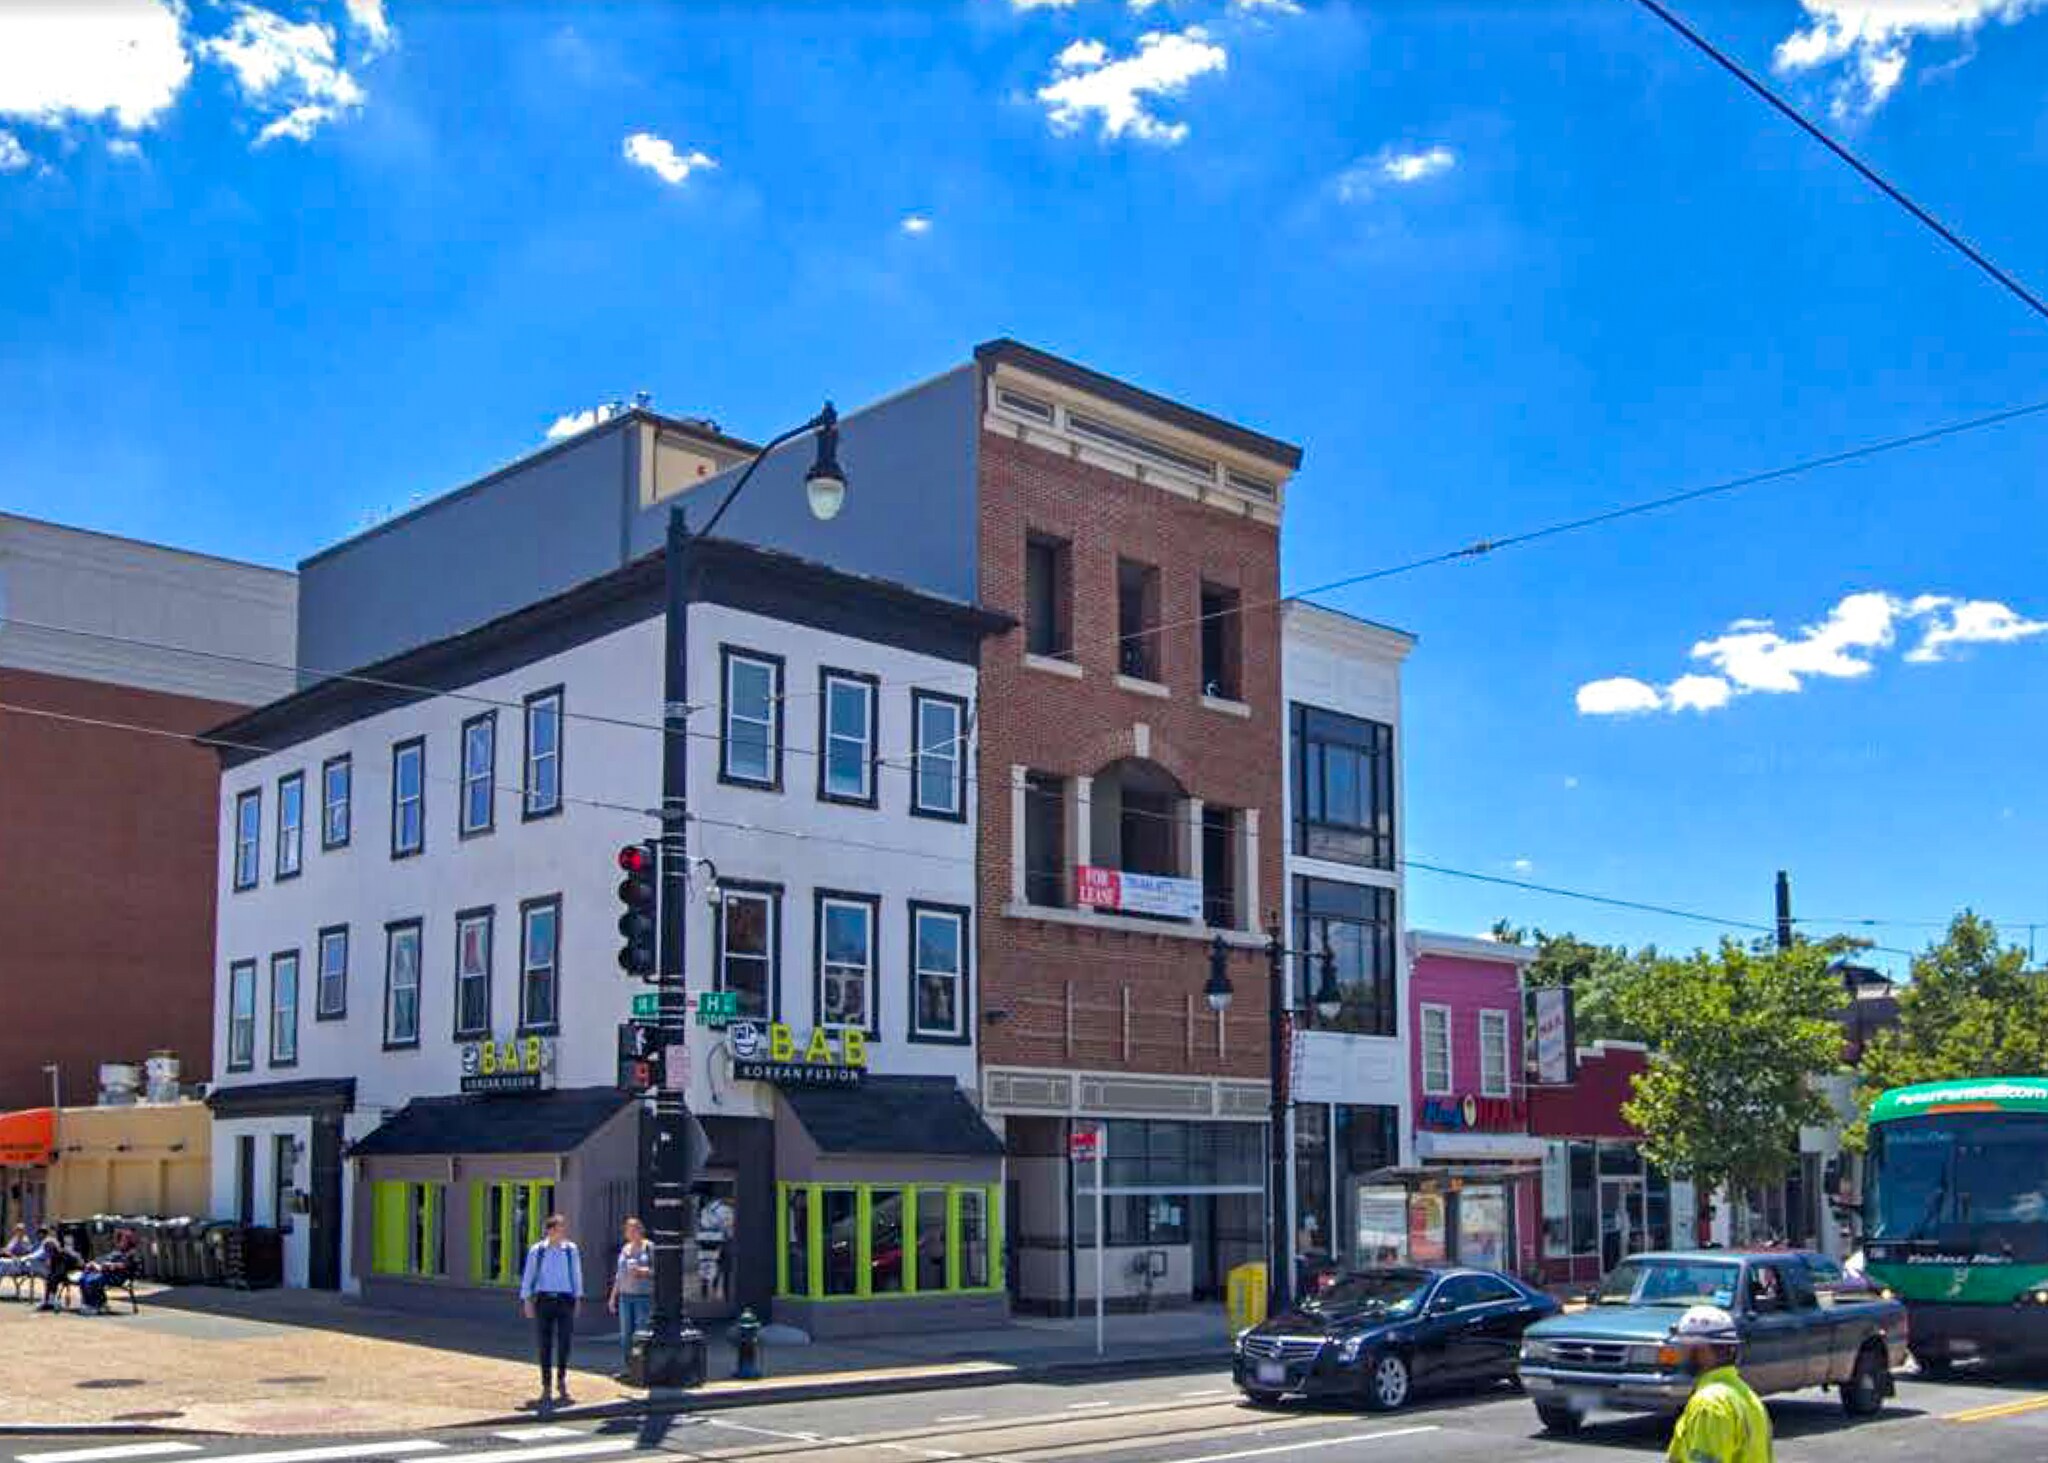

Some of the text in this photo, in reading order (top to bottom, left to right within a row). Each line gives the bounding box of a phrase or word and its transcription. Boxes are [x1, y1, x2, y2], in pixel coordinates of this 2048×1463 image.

[1085, 868, 1109, 888] FOR
[1079, 886, 1115, 907] LEASE
[706, 995, 719, 1012] H
[743, 1065, 859, 1082] KOREAN FUSION
